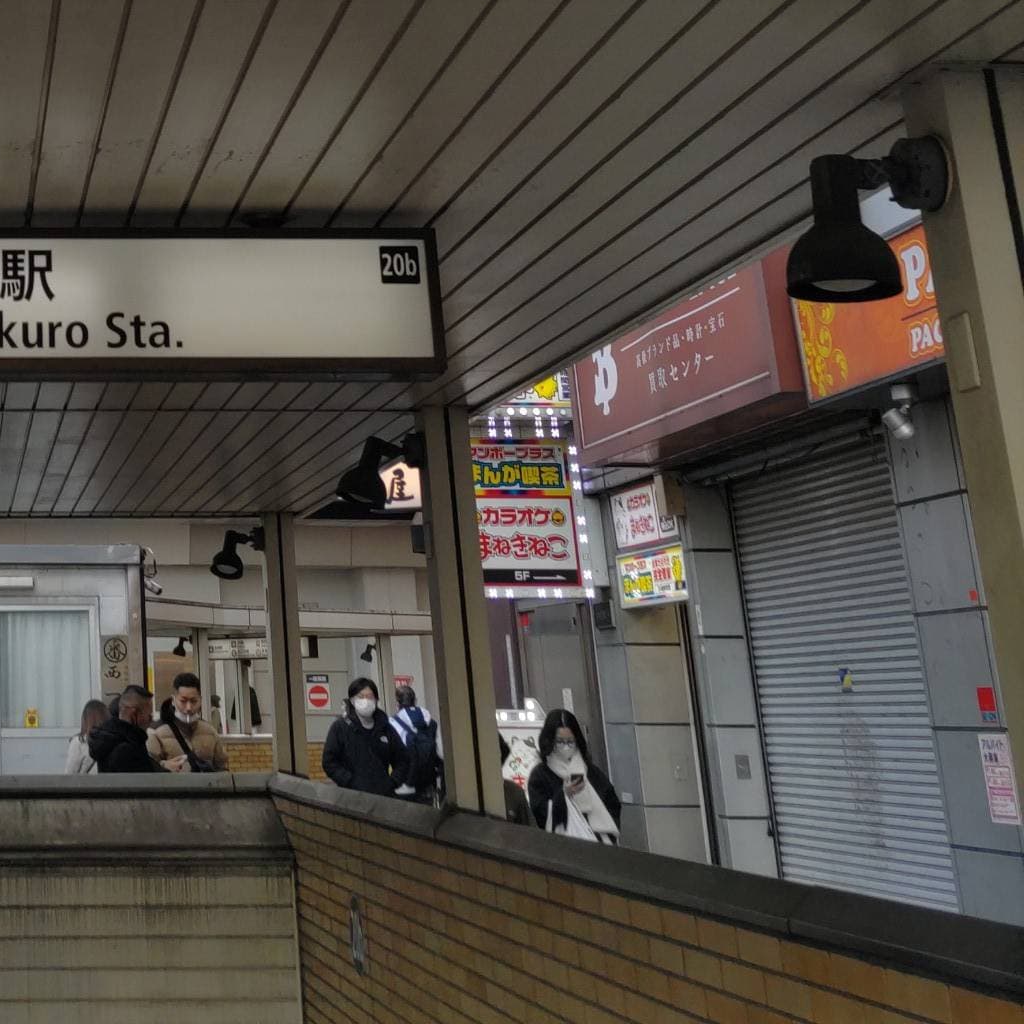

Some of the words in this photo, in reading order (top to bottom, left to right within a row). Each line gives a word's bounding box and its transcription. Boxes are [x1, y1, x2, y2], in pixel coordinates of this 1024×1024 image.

[381, 252, 417, 276] 20b
[105, 312, 184, 349] Sta.
[483, 508, 551, 525] カラオケ
[514, 570, 531, 581] 5F
